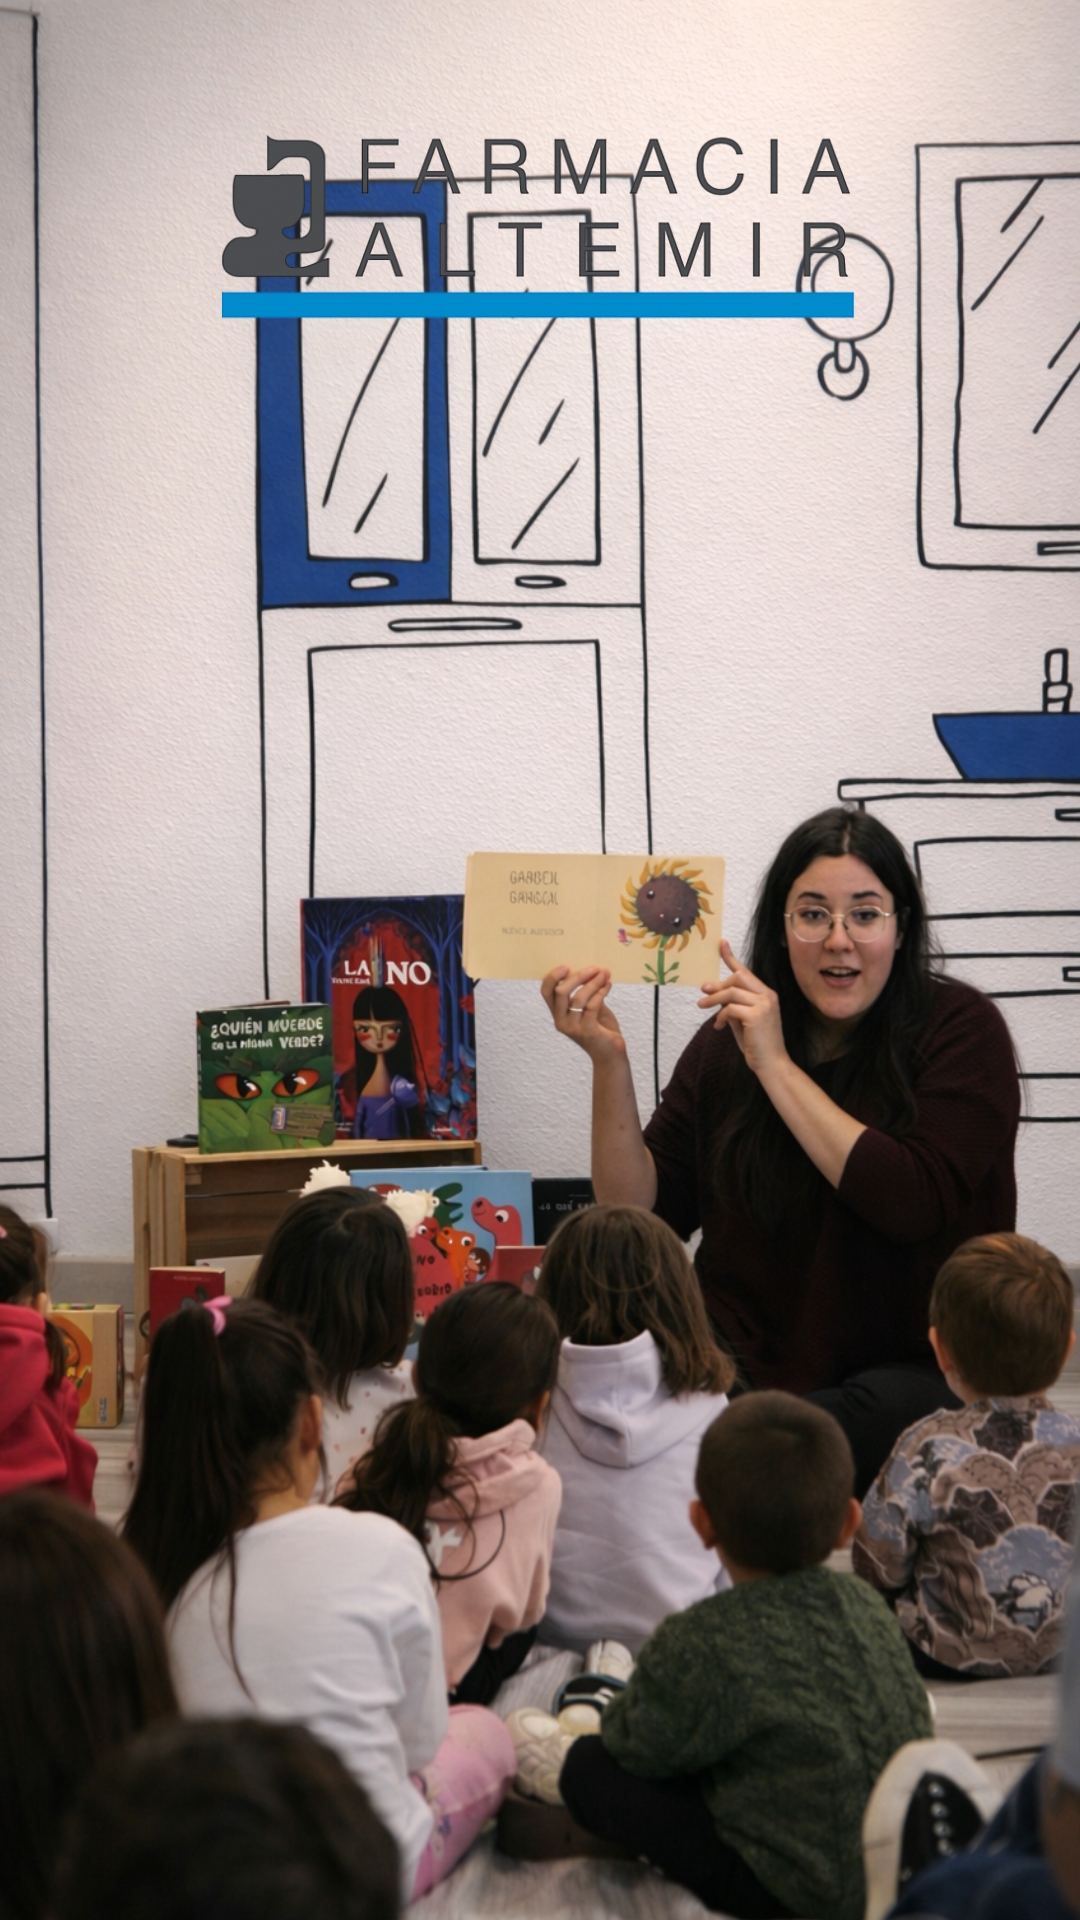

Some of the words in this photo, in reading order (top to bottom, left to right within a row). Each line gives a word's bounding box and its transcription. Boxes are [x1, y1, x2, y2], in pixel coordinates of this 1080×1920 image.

[344, 960, 371, 976] LA
[385, 961, 431, 985] NO
[210, 1017, 263, 1039] ¿QUIÉN
[267, 1017, 324, 1033] MUERDE
[279, 1034, 325, 1049] VERDE?
